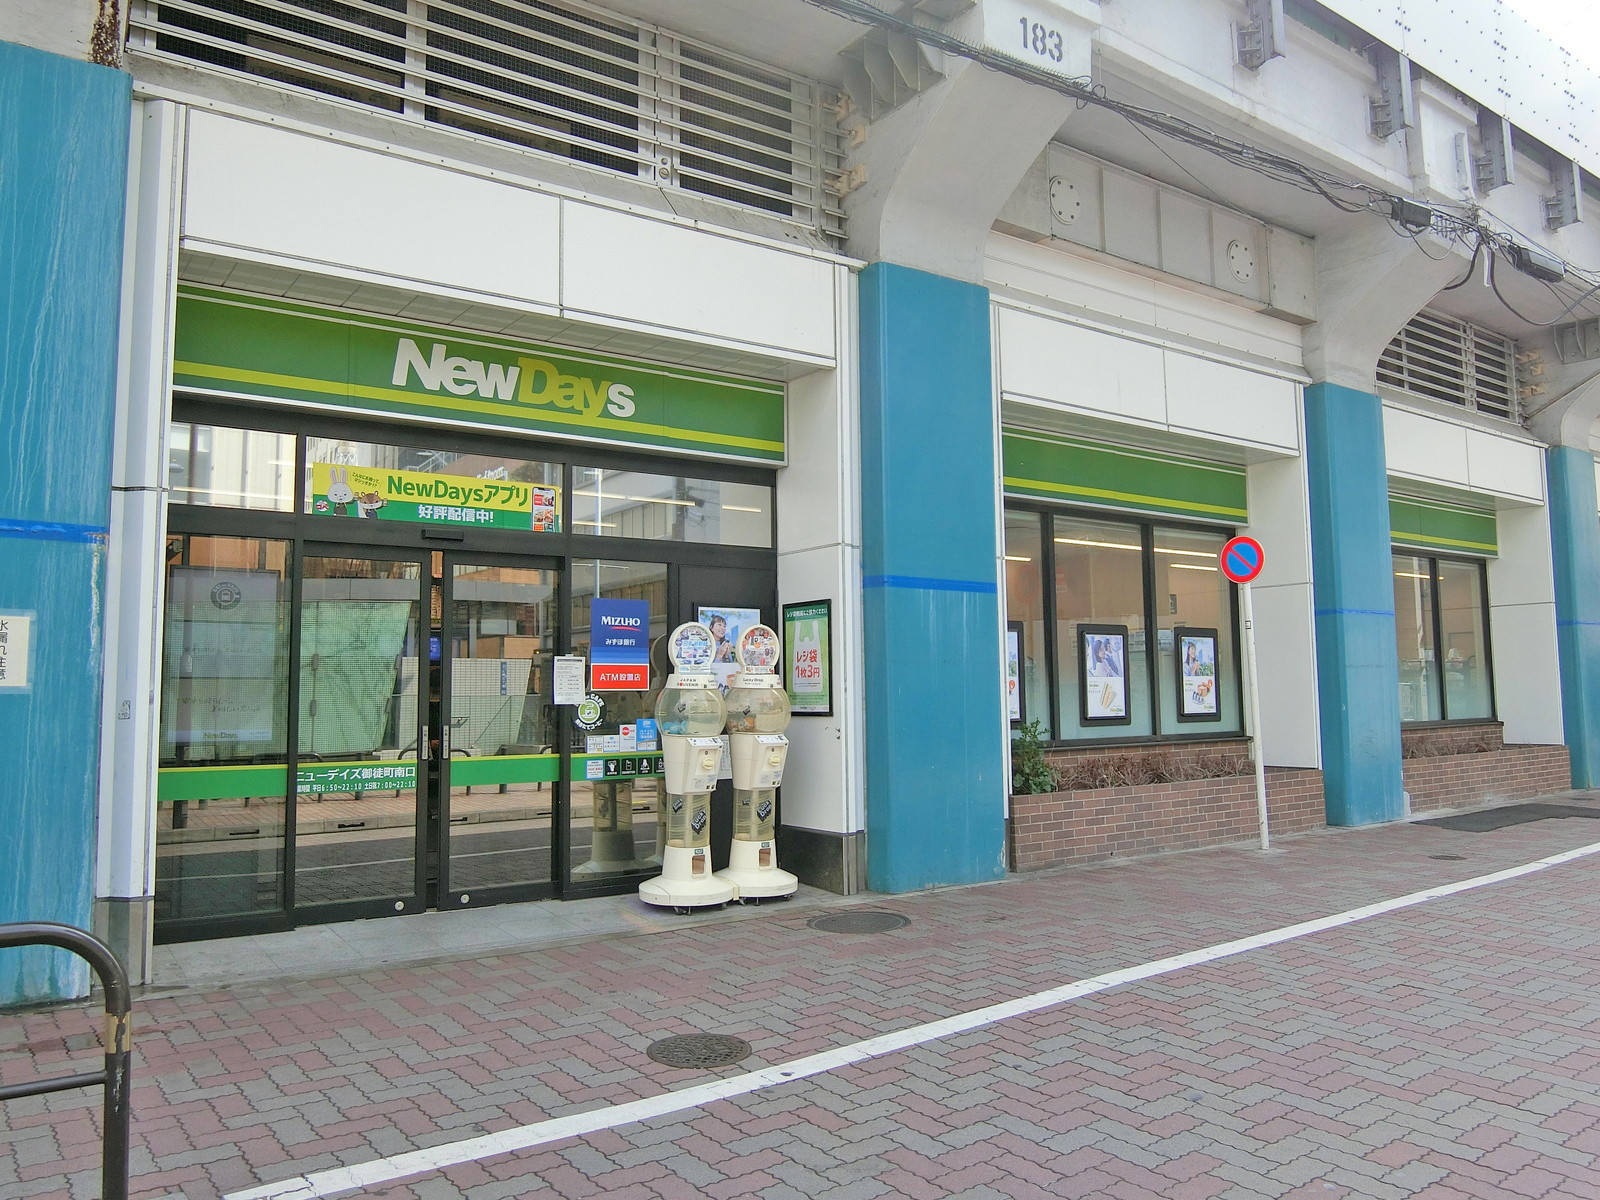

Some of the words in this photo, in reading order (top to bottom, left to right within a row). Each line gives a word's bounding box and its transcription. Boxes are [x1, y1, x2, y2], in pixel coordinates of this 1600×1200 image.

[1019, 16, 1064, 63] 183
[391, 337, 637, 420] NewDays
[387, 475, 529, 507] NewDaysアプリ
[417, 504, 495, 524] 好評配信中!
[601, 615, 641, 627] MIZUHO
[605, 638, 636, 646] みずほ銀行
[796, 649, 818, 663] レジ袋
[795, 665, 821, 679] 1枚3円
[590, 693, 605, 707] CAFE
